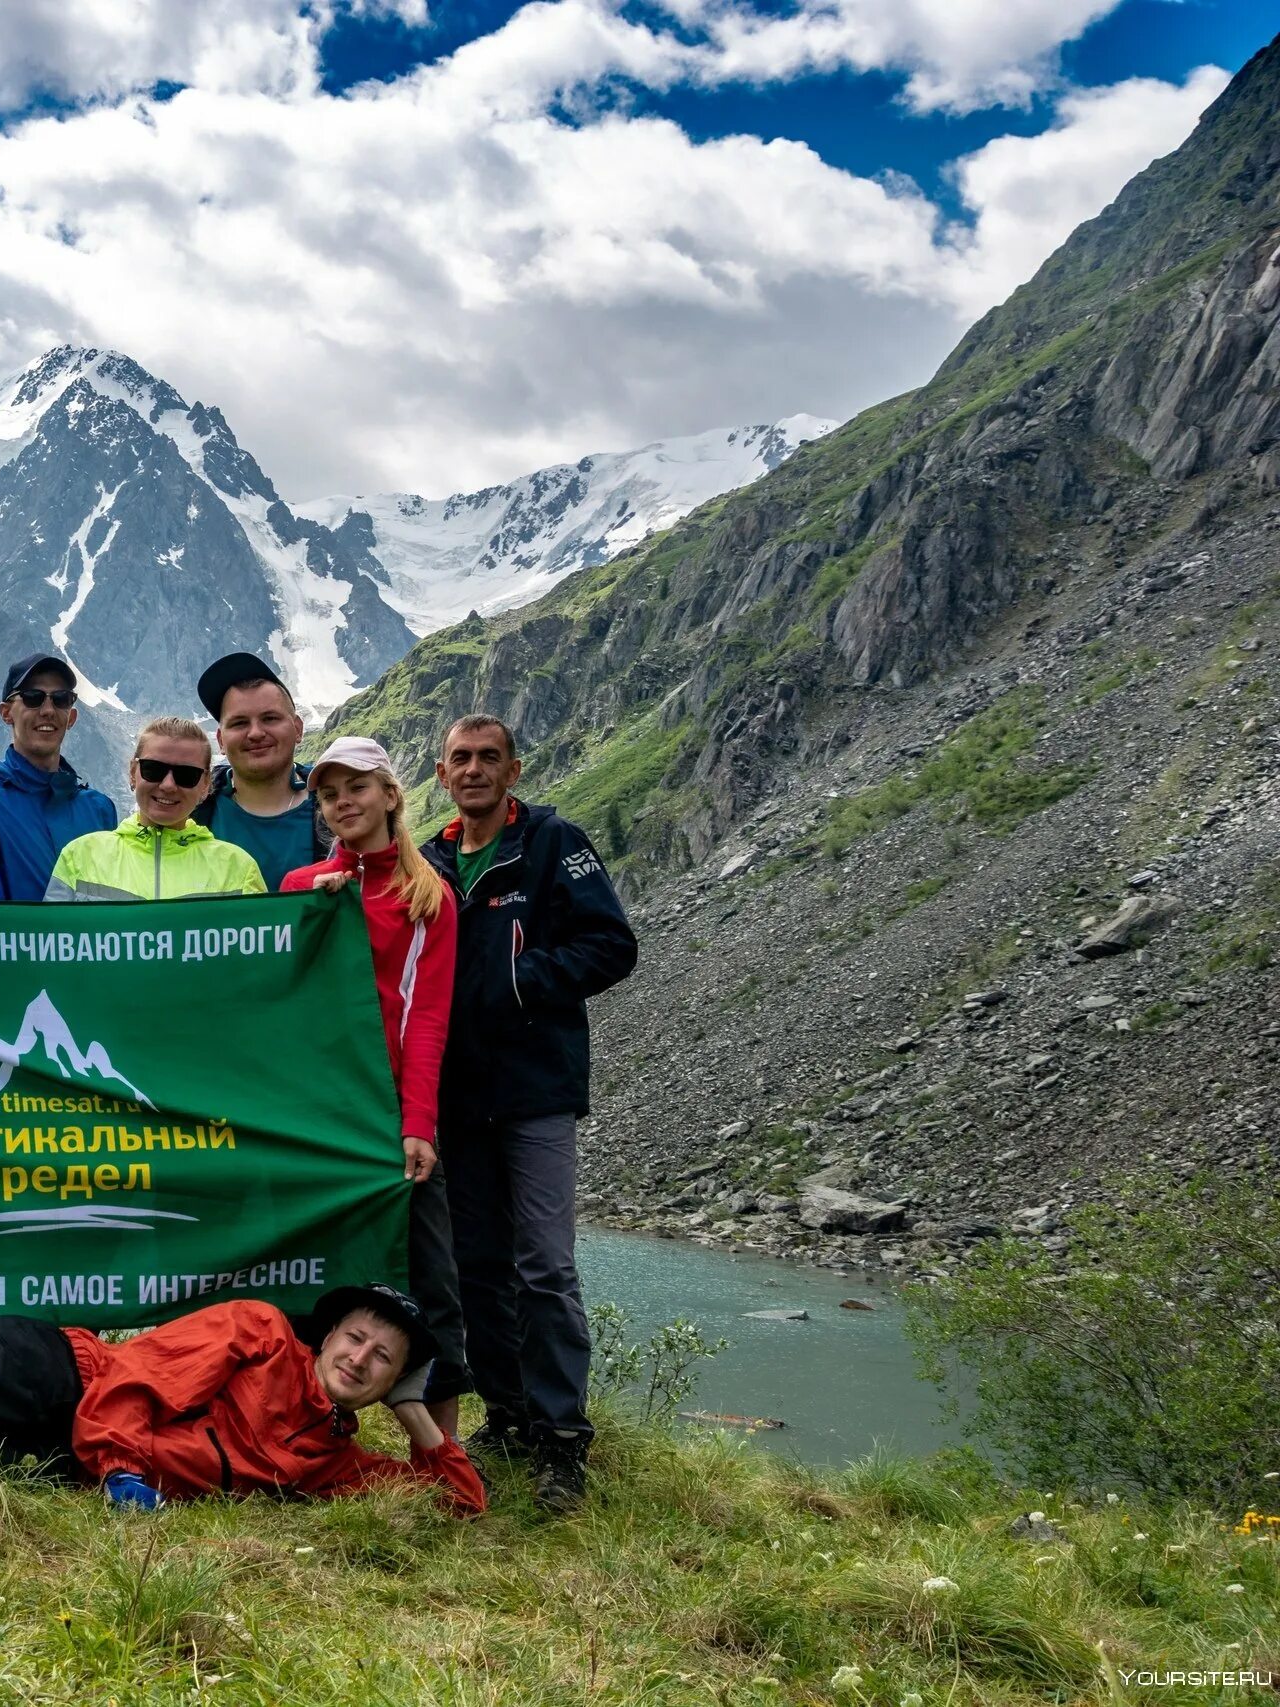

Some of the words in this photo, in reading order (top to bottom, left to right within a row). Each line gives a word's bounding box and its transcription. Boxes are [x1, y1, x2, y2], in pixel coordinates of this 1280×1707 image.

[181, 923, 293, 963] ДОРОГИ
[21, 1274, 124, 1306] САМОЕ
[139, 1257, 326, 1305] ИНТЕРЕСНОЕ
